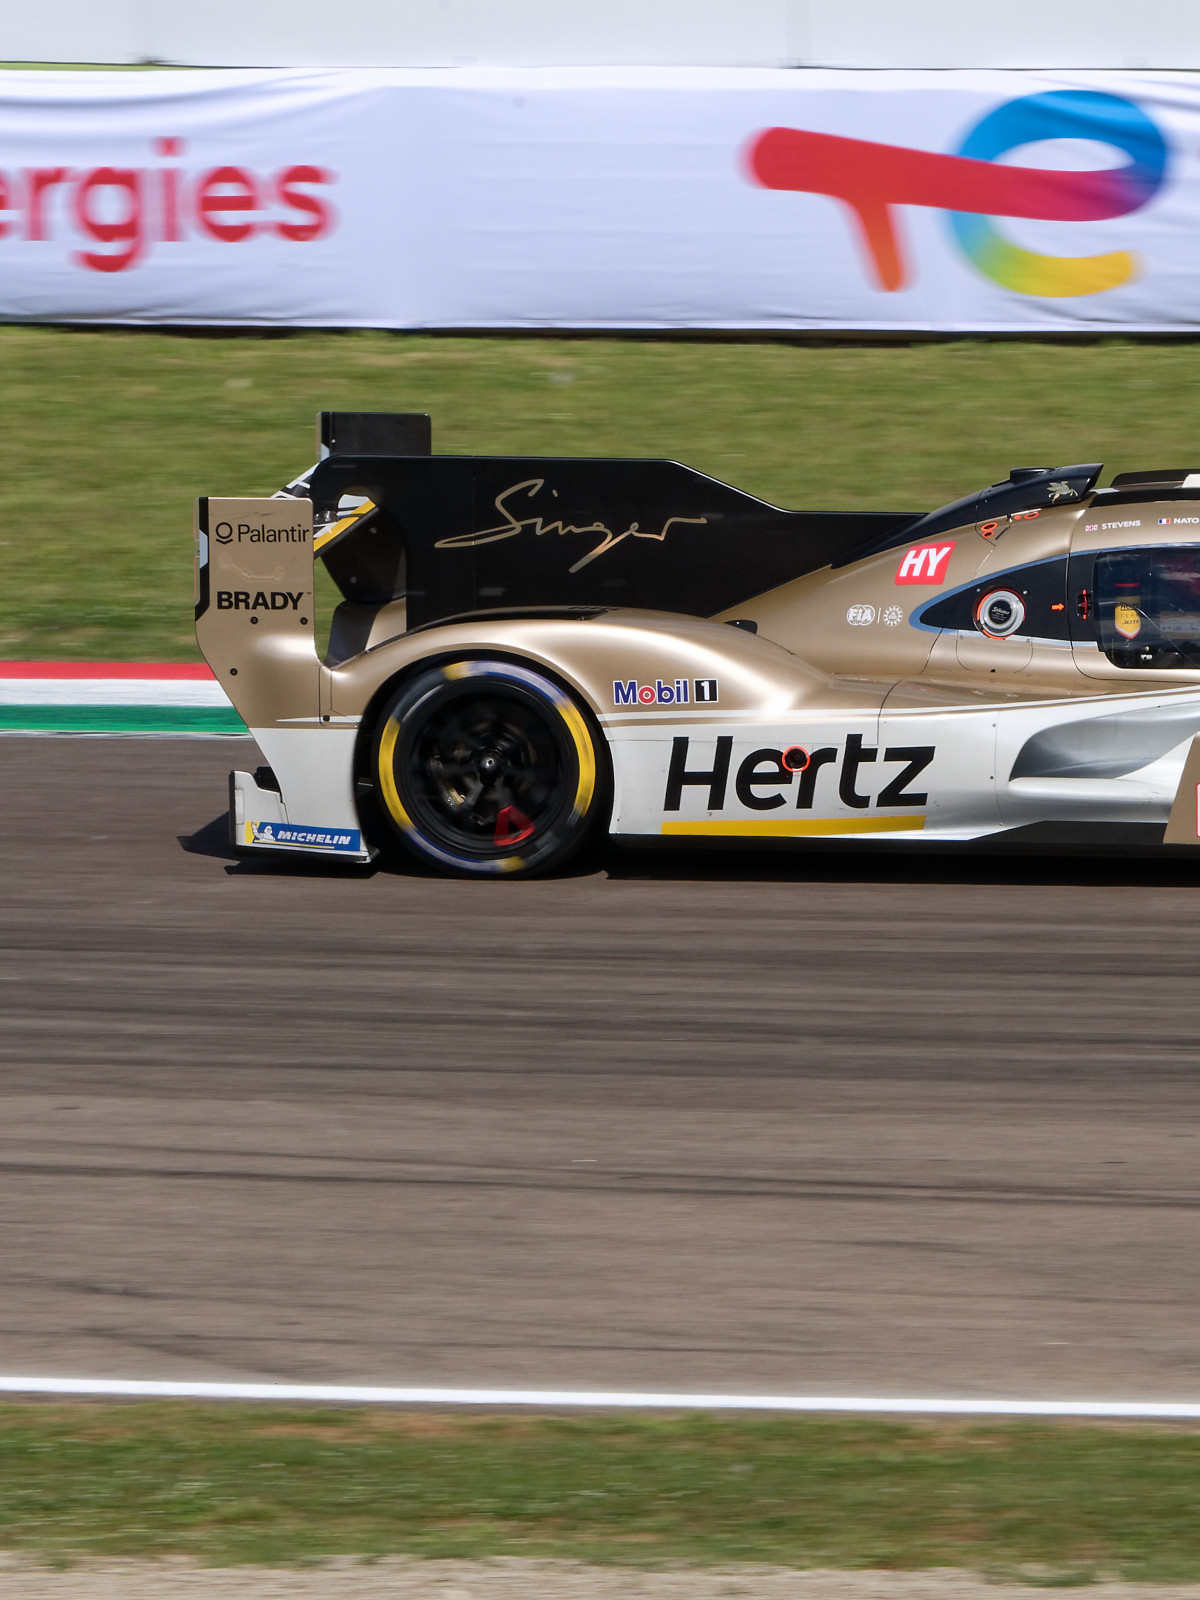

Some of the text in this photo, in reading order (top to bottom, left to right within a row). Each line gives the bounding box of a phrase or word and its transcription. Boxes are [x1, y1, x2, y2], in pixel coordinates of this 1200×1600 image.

[434, 479, 707, 573] Singer
[1101, 520, 1141, 530] STEVENS
[1173, 517, 1200, 525] NATO
[237, 524, 310, 543] Palantir
[899, 546, 952, 577] HY
[217, 591, 304, 610] BRADY
[613, 679, 690, 704] Mobil
[663, 733, 936, 811] Hertz
[276, 830, 352, 845] MICHELIN
